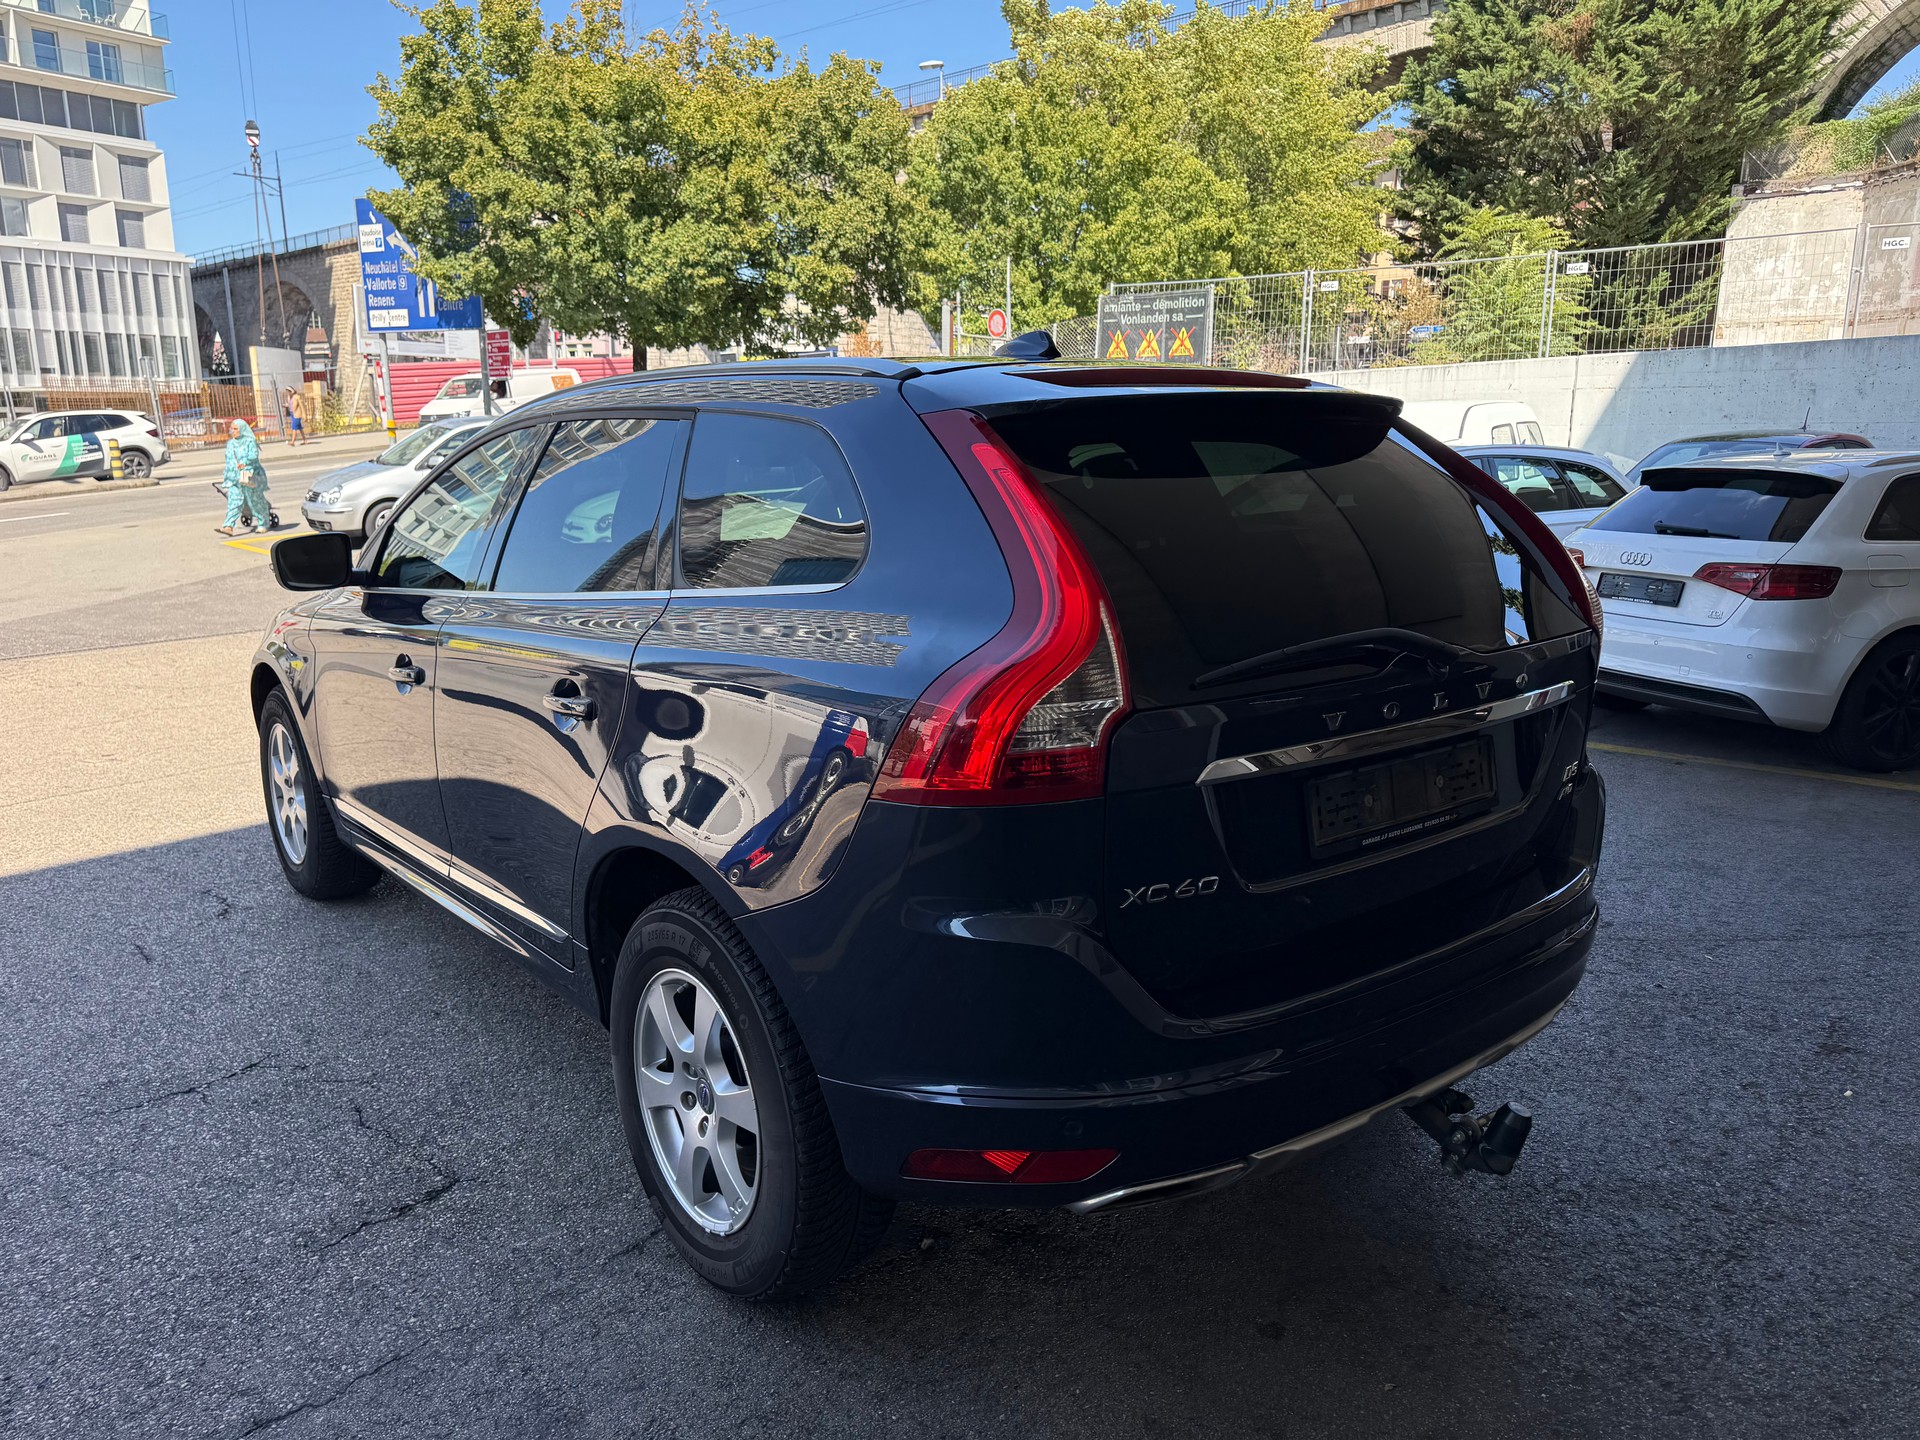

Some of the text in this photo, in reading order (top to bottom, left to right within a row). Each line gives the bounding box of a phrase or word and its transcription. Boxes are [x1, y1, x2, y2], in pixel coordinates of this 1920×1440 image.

[1884, 239, 1905, 247] HGC
[364, 260, 398, 274] Neuchâtel
[366, 278, 397, 291] Vallorbe
[368, 294, 396, 307] Renens
[437, 298, 464, 311] Centre
[1152, 296, 1205, 310] démolition
[1120, 311, 1184, 325] Vonlanden sa
[1322, 673, 1529, 731] VOLVO
[714, 968, 740, 1011] ROTATION
